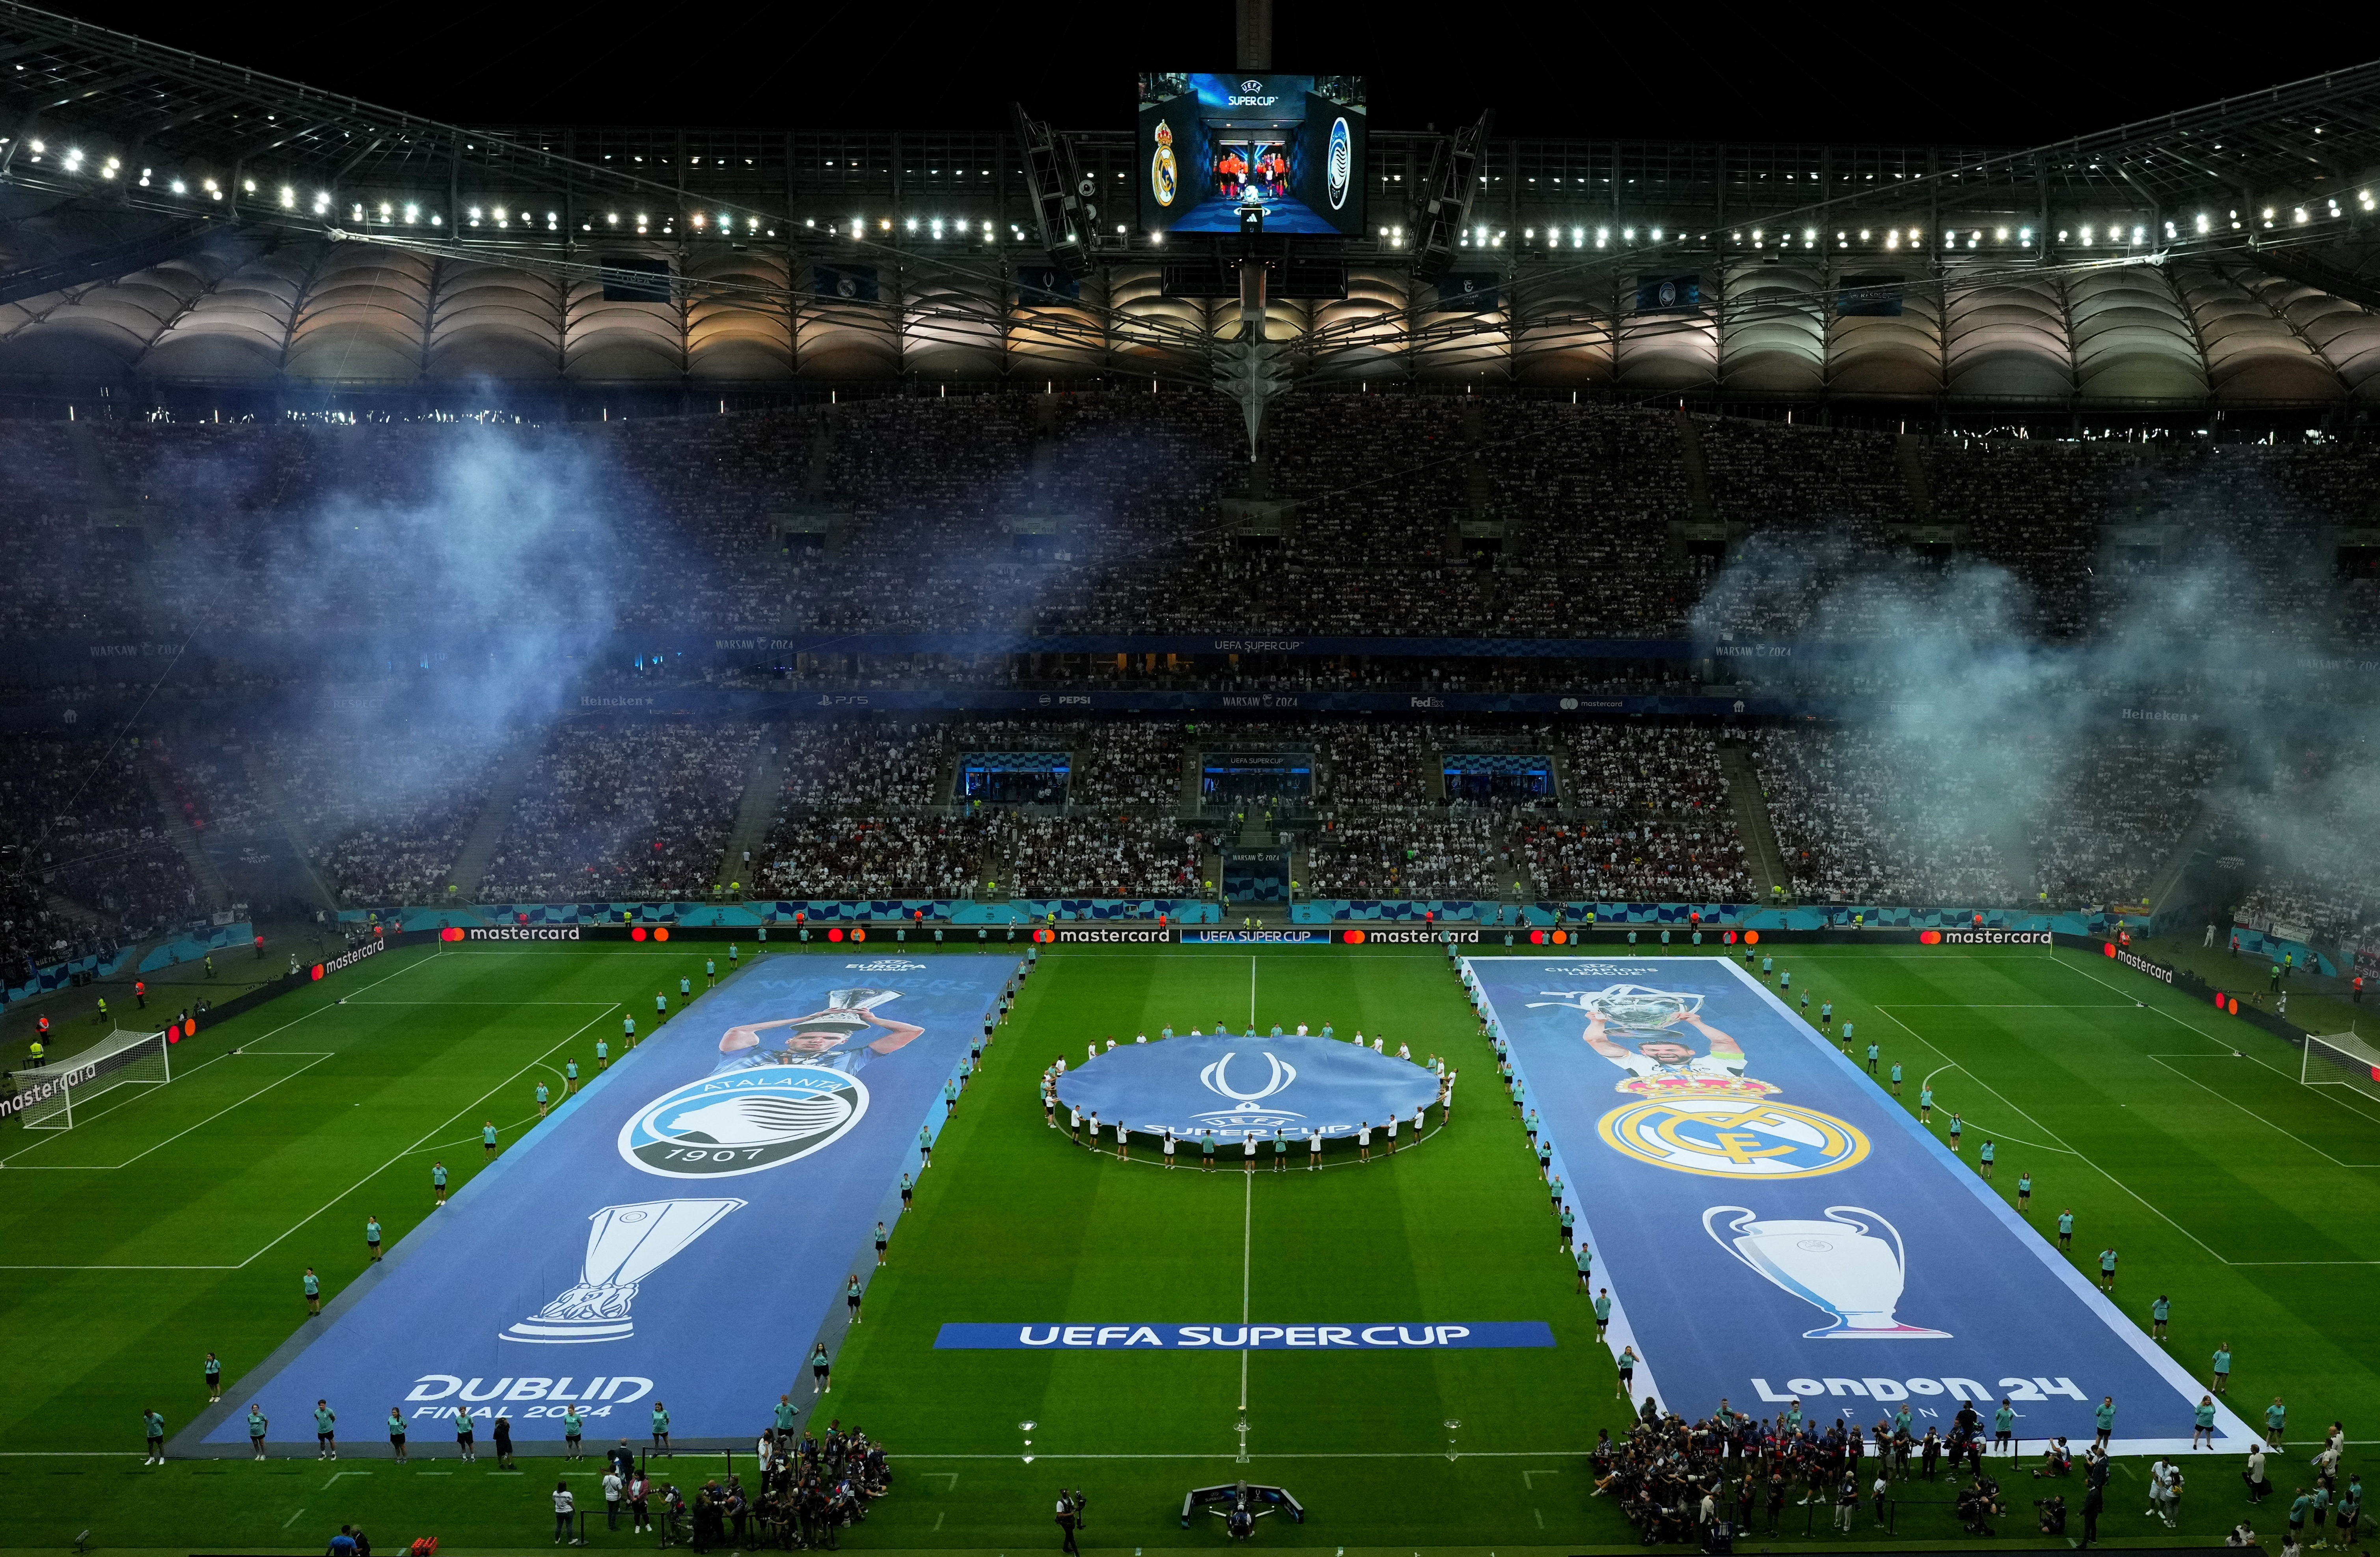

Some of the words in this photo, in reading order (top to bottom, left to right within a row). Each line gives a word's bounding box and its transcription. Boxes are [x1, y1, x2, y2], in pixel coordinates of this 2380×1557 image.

[1242, 82, 1261, 92] UEFA
[90, 645, 137, 656] WARSAW
[716, 640, 754, 649] WARSAW
[770, 640, 793, 649] 2024
[1215, 641, 1241, 649] UEFA
[1245, 641, 1277, 649] SUPER
[1279, 641, 1299, 650] CUP
[1716, 646, 1754, 656] WARSAW
[1769, 647, 1791, 656] 2024
[2359, 661, 2380, 672] 202
[581, 696, 643, 706] Heineken
[1223, 697, 1260, 706] WARSAW
[1276, 697, 1297, 707] 2024
[1411, 697, 1444, 707] FedEx
[2122, 709, 2188, 722] Heineken
[471, 927, 579, 940] mastercard
[1061, 929, 1169, 942] mastercard
[1200, 931, 1235, 942] UEFA
[1239, 931, 1282, 942] SUPER
[1284, 931, 1311, 942] CUP
[1946, 930, 2052, 944] mastercard
[326, 937, 384, 974] mastercard
[2118, 949, 2172, 984] mastercard
[760, 978, 984, 990] WINNERS
[704, 1078, 844, 1091] ATALANTA
[1206, 1118, 1286, 1126] UEFA
[664, 1148, 765, 1162] 1907
[1019, 1326, 1163, 1346] UEFA
[1177, 1326, 1360, 1346] SUPER
[1360, 1326, 1471, 1345] CUP
[1998, 1377, 2089, 1401] 24
[411, 1406, 513, 1418] FINAL
[523, 1405, 612, 1418] 2024
